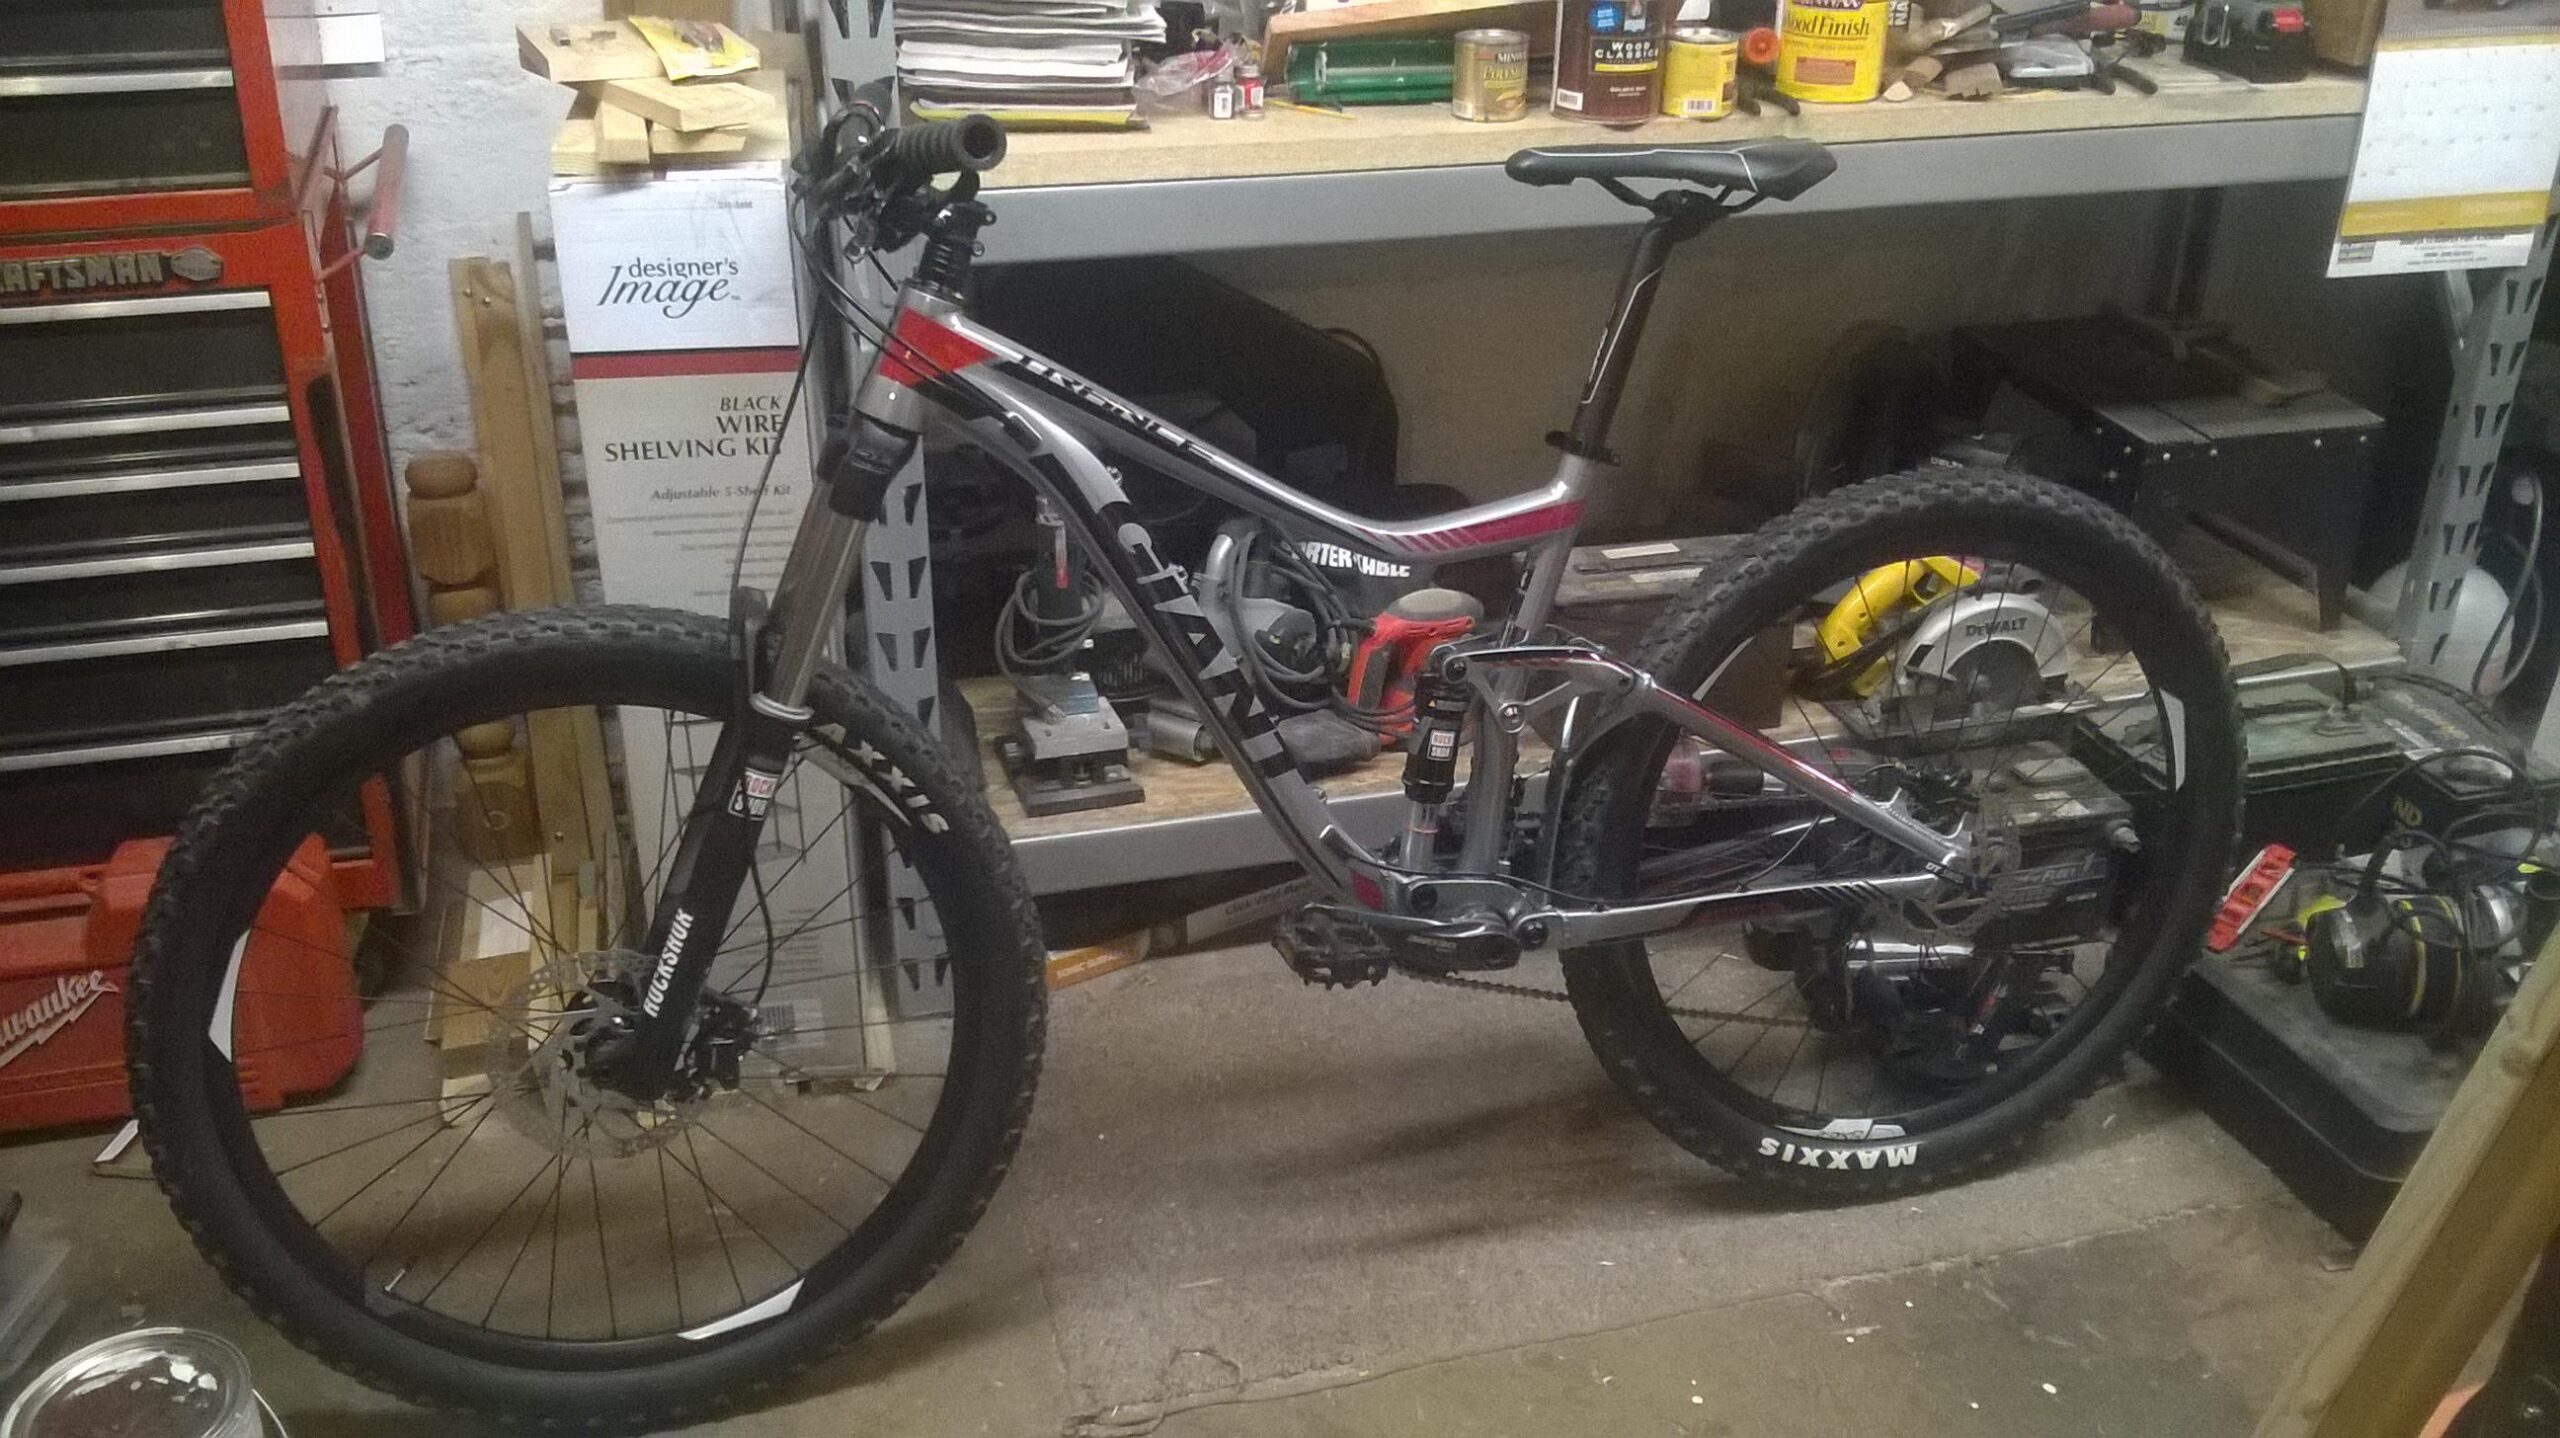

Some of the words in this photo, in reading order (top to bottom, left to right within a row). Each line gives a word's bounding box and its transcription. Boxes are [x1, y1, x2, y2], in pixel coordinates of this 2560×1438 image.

[1818, 15, 1871, 36] Finish
[1611, 41, 1651, 51] WOOD
[0, 252, 163, 293] AFTSMAN
[628, 257, 739, 279] designer's
[597, 265, 731, 319] Image
[720, 395, 784, 412] BLACK
[716, 414, 785, 434] WIRE
[604, 437, 737, 462] SHELVING
[652, 485, 720, 503] Adjustable
[725, 483, 769, 497] 5-Shef
[774, 484, 791, 496] Kit
[812, 722, 950, 835] AXXIS
[643, 907, 695, 1019] ROCKSHOX
[0, 969, 104, 1048] waukee
[1757, 1137, 1919, 1171] MAXXIS
